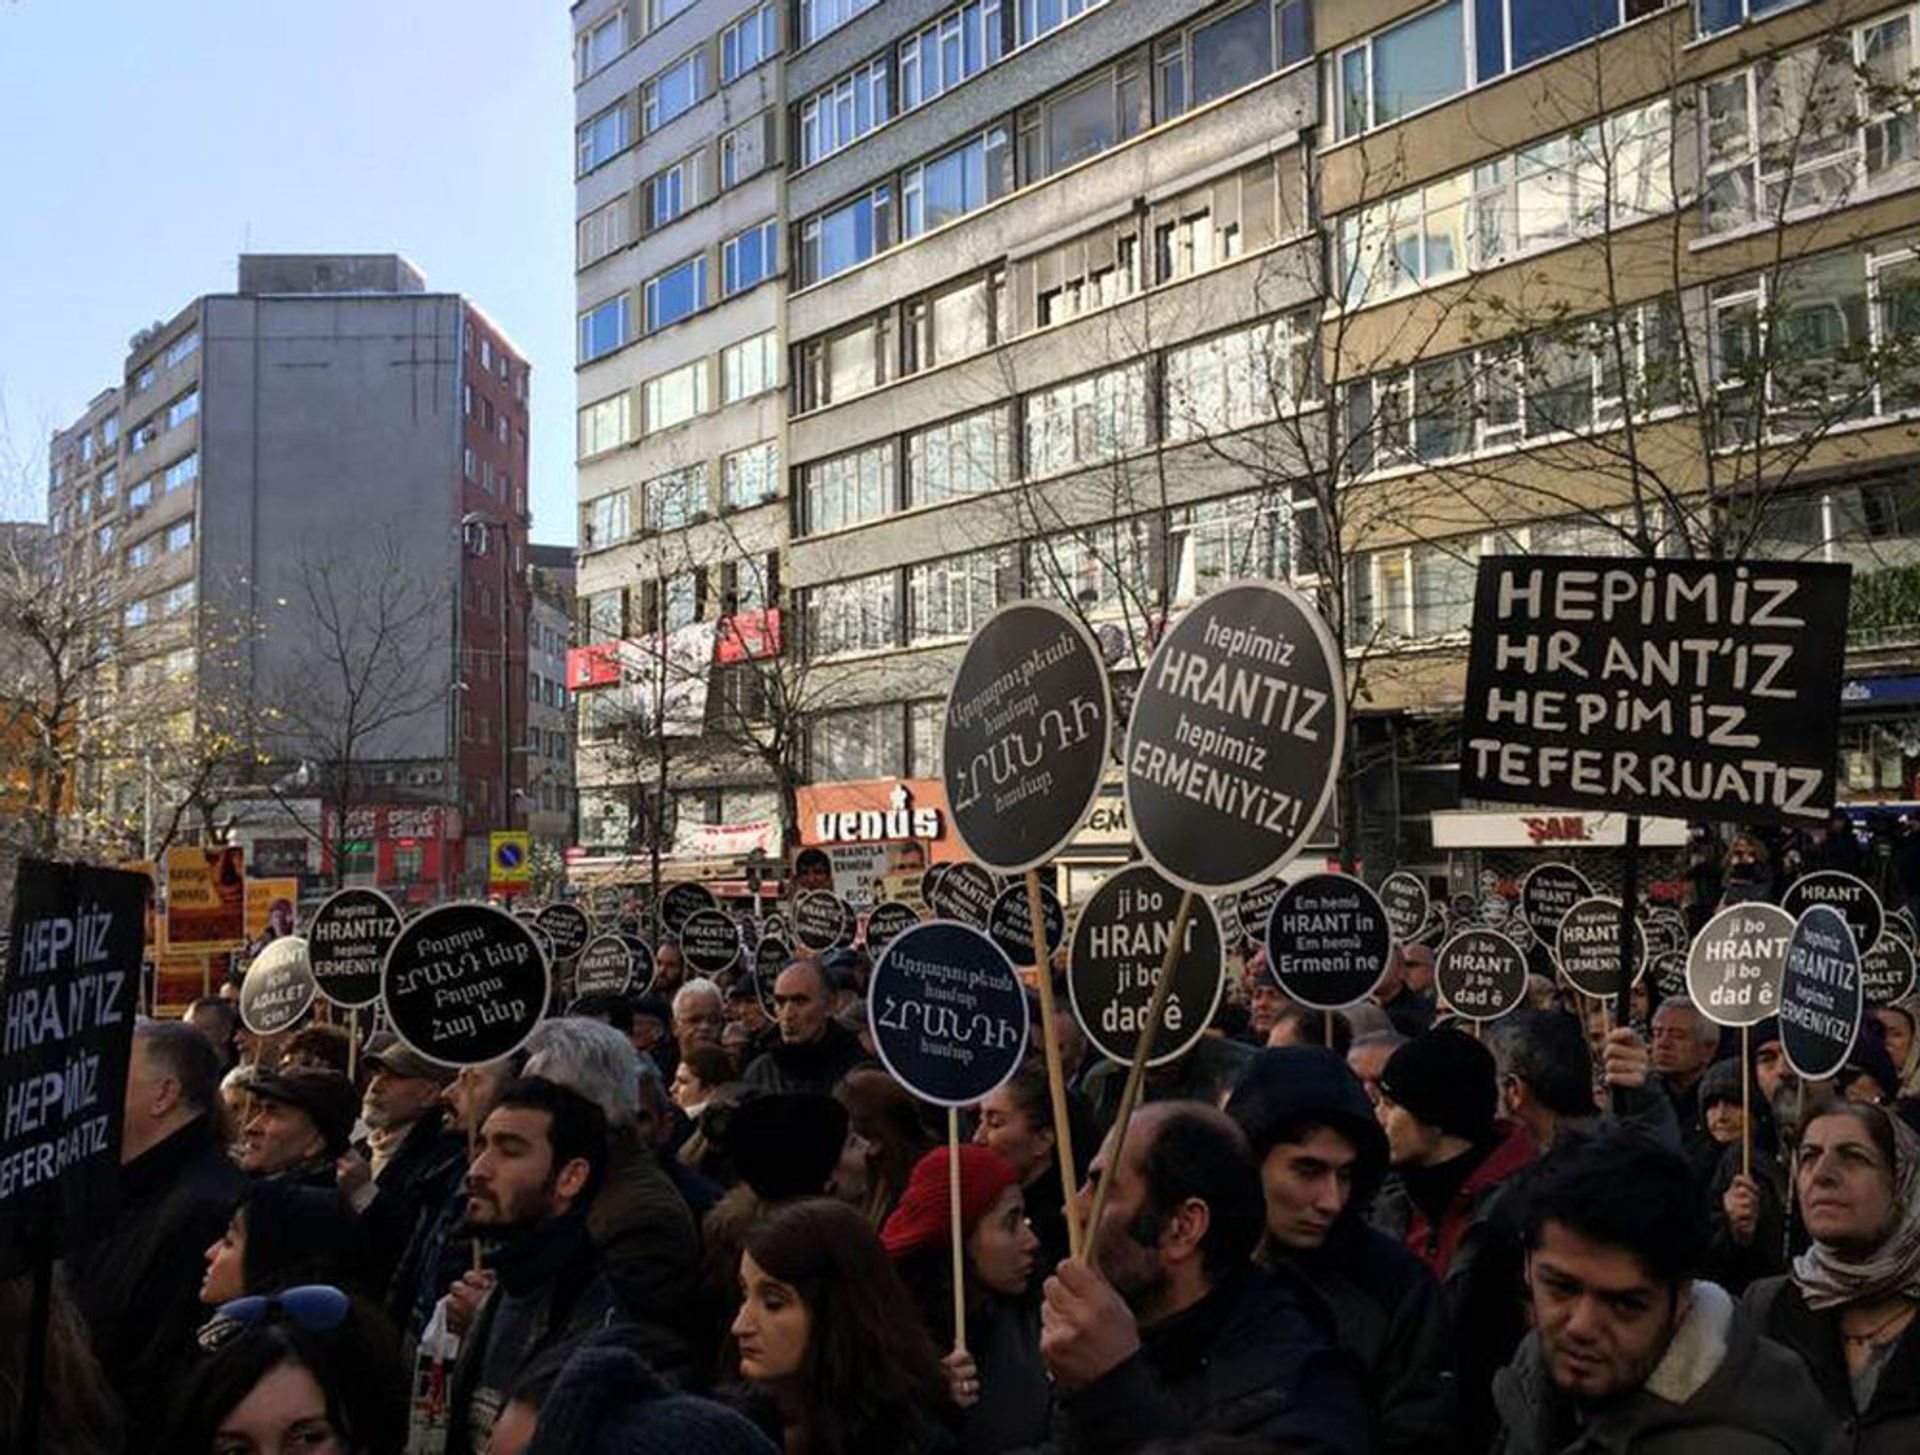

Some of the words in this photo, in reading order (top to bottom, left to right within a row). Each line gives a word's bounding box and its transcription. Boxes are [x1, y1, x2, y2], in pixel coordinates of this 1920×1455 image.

[1497, 566, 1806, 628] HEPİMİZ
[1203, 617, 1297, 668] hepimiz
[1496, 630, 1798, 699] HRANT'IZ
[1157, 647, 1329, 742] HRANTIZ
[1485, 687, 1761, 748] HEPİMİZ
[1175, 714, 1268, 772] hepimiz
[1468, 738, 1830, 819] TEFERRUATIZ
[1117, 888, 1131, 920] ji
[1137, 888, 1163, 912] bo
[1800, 884, 1863, 901] HRANT
[316, 917, 396, 941] HRANTIZ
[1281, 912, 1352, 934] HRANT
[1355, 911, 1375, 932] in
[1563, 924, 1620, 944] HRANT
[1728, 919, 1740, 938] ji
[1744, 918, 1767, 934] bo
[1090, 918, 1198, 959] HRANT
[1705, 938, 1789, 961] HRANT
[1280, 950, 1352, 973] Ermenî
[1355, 954, 1379, 972] ne
[1449, 954, 1515, 974] HRANT
[1723, 963, 1736, 983] ji
[1739, 963, 1762, 979] bo
[1788, 944, 1855, 991] HRANTIZ
[1117, 963, 1132, 994] ji
[1137, 963, 1163, 987] bo
[1861, 971, 1903, 984] DALET
[1454, 988, 1488, 1006] dad
[1709, 984, 1752, 1006] dad
[1758, 982, 1774, 1005] ê
[877, 996, 1018, 1049] ՀՐԱՆԴԻ
[1164, 992, 1183, 1031] ê
